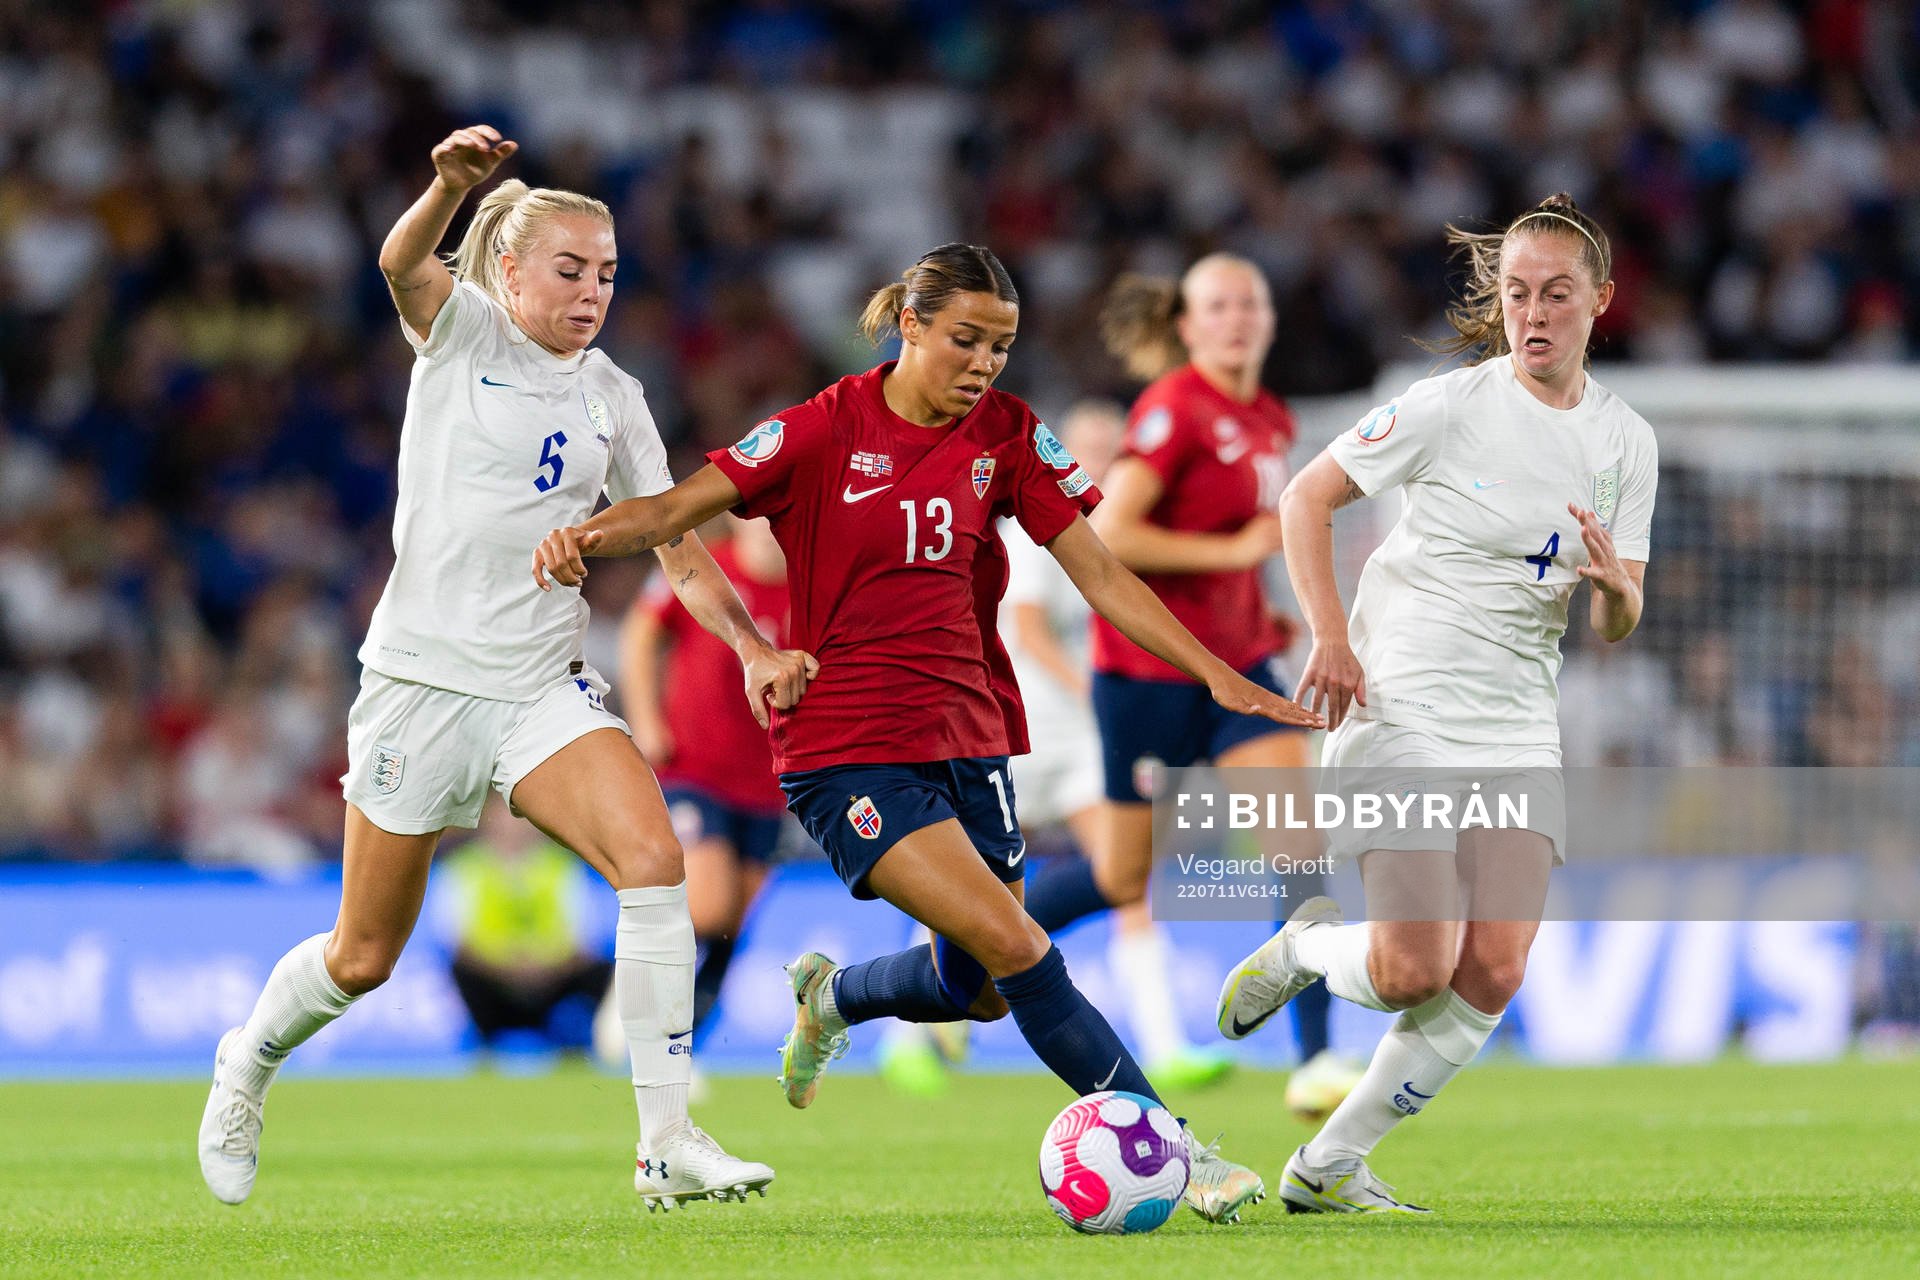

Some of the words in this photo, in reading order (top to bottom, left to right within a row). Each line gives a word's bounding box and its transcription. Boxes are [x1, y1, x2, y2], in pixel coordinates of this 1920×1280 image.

[533, 430, 568, 493] 5
[900, 497, 953, 564] 13
[1525, 531, 1560, 582] 4
